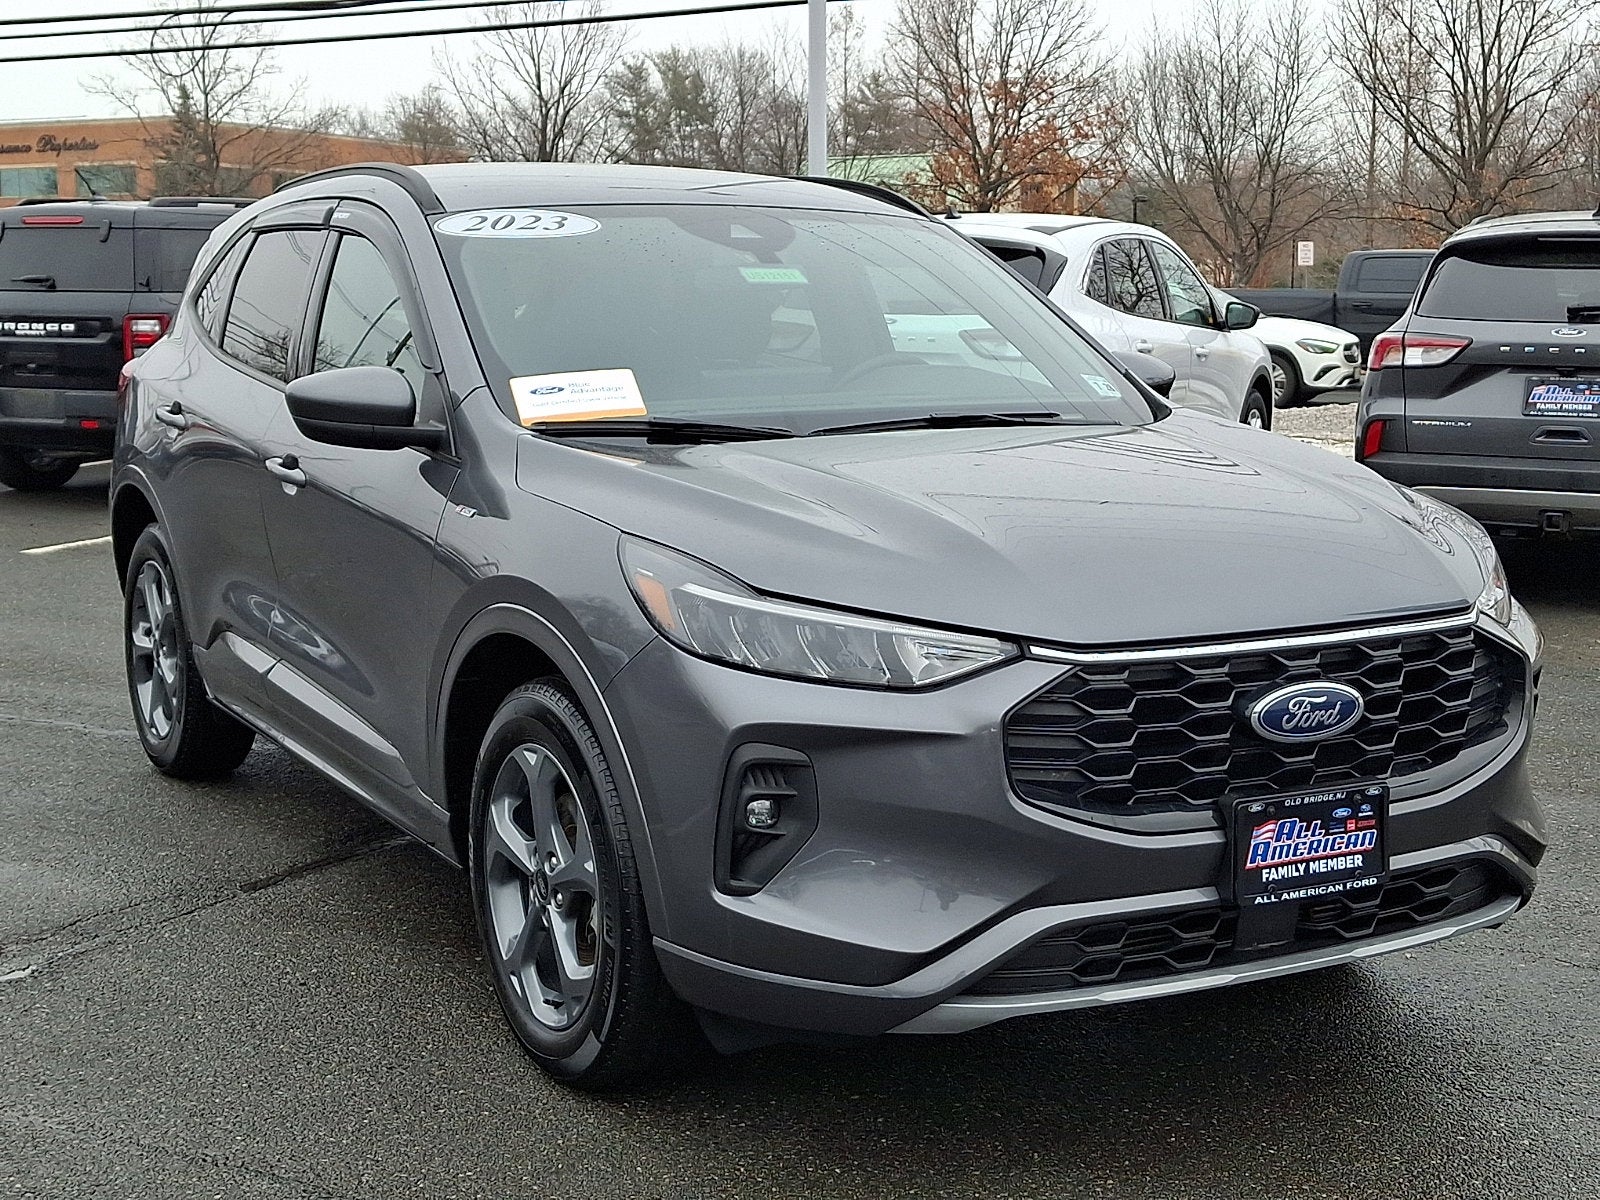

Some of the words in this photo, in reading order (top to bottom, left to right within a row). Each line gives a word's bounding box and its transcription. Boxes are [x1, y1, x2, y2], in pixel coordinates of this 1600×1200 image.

[463, 214, 568, 231] 2023
[0, 322, 75, 332] RONCO
[1282, 695, 1342, 730] Ford
[1285, 799, 1302, 807] OLD
[1274, 818, 1325, 842] ALL
[1246, 829, 1377, 867] AMERICAN
[1262, 862, 1306, 882] FAMILY
[1309, 854, 1363, 874] MEMBER
[1254, 894, 1279, 904] ALL
[1280, 883, 1344, 901] AMERICAN
[1346, 877, 1378, 890] FORD
